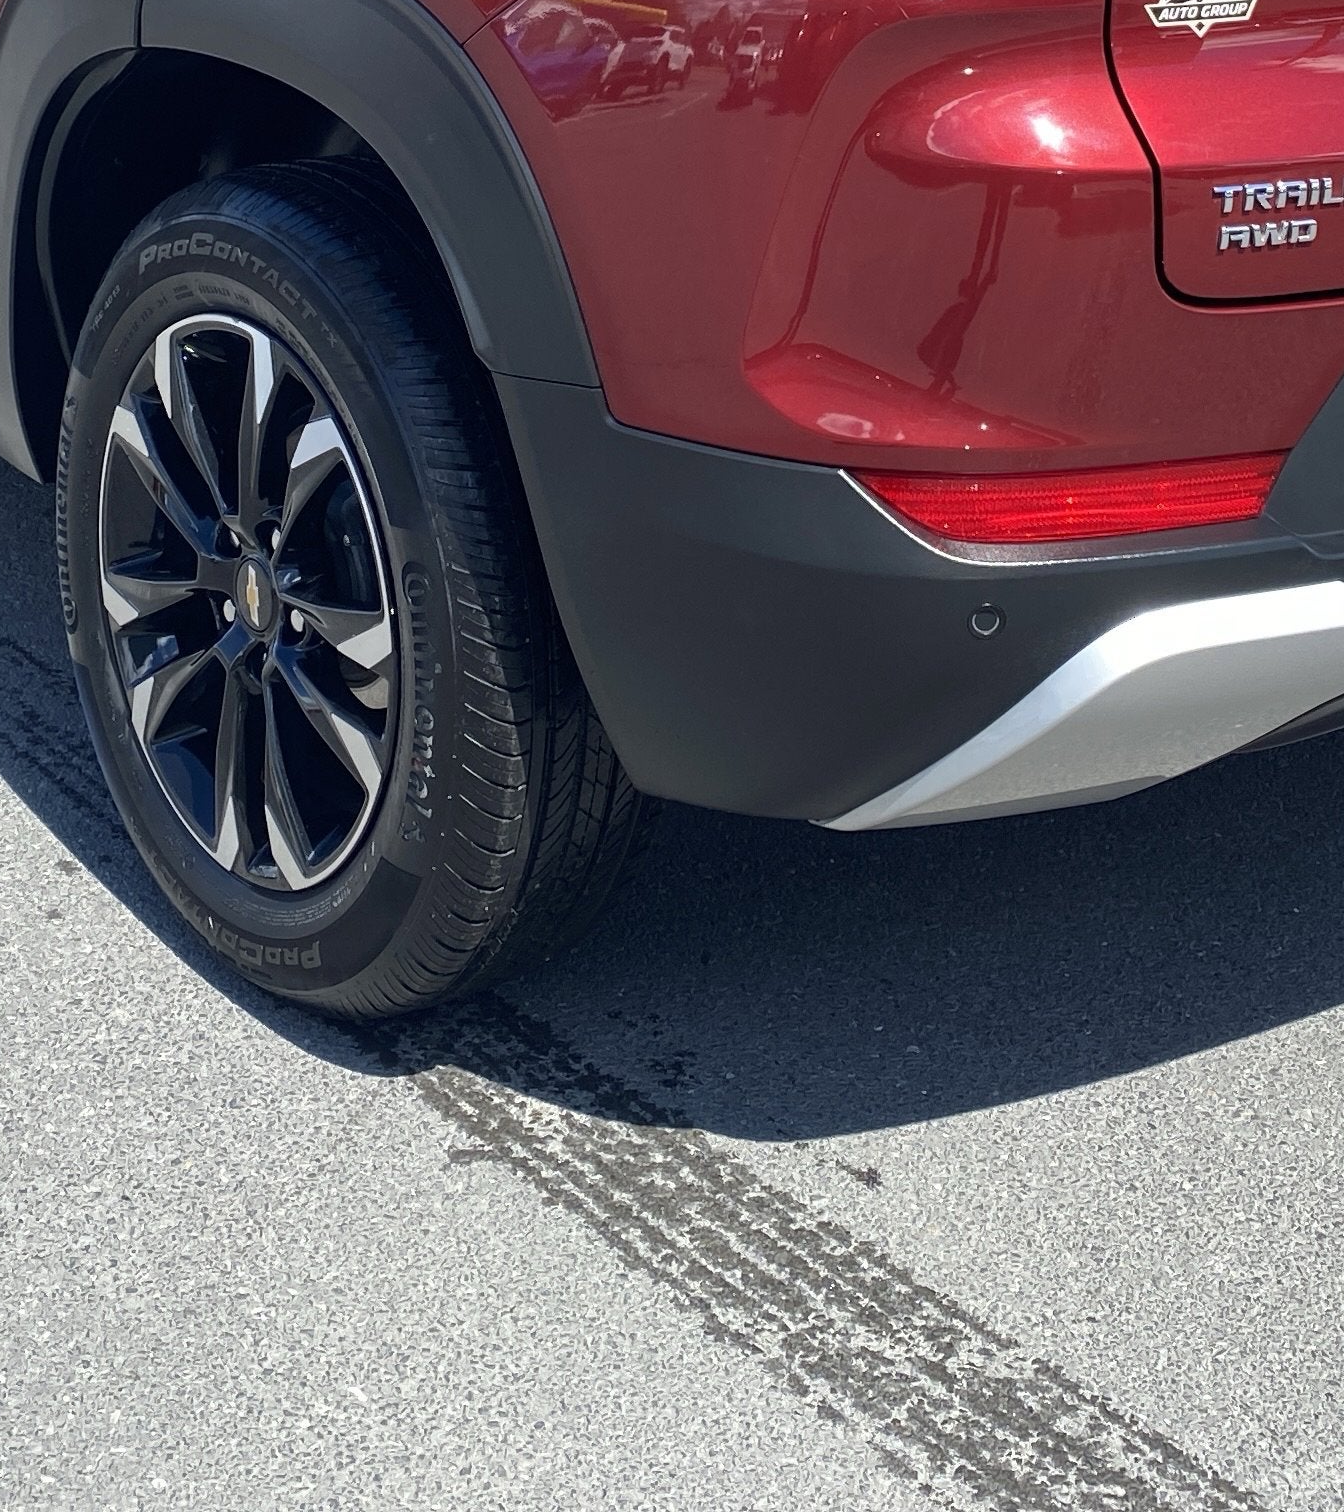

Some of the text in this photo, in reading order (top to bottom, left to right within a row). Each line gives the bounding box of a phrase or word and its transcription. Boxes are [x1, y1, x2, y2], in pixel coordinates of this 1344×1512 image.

[1158, 2, 1248, 21] AUTO GROUP
[1218, 218, 1318, 251] AWD
